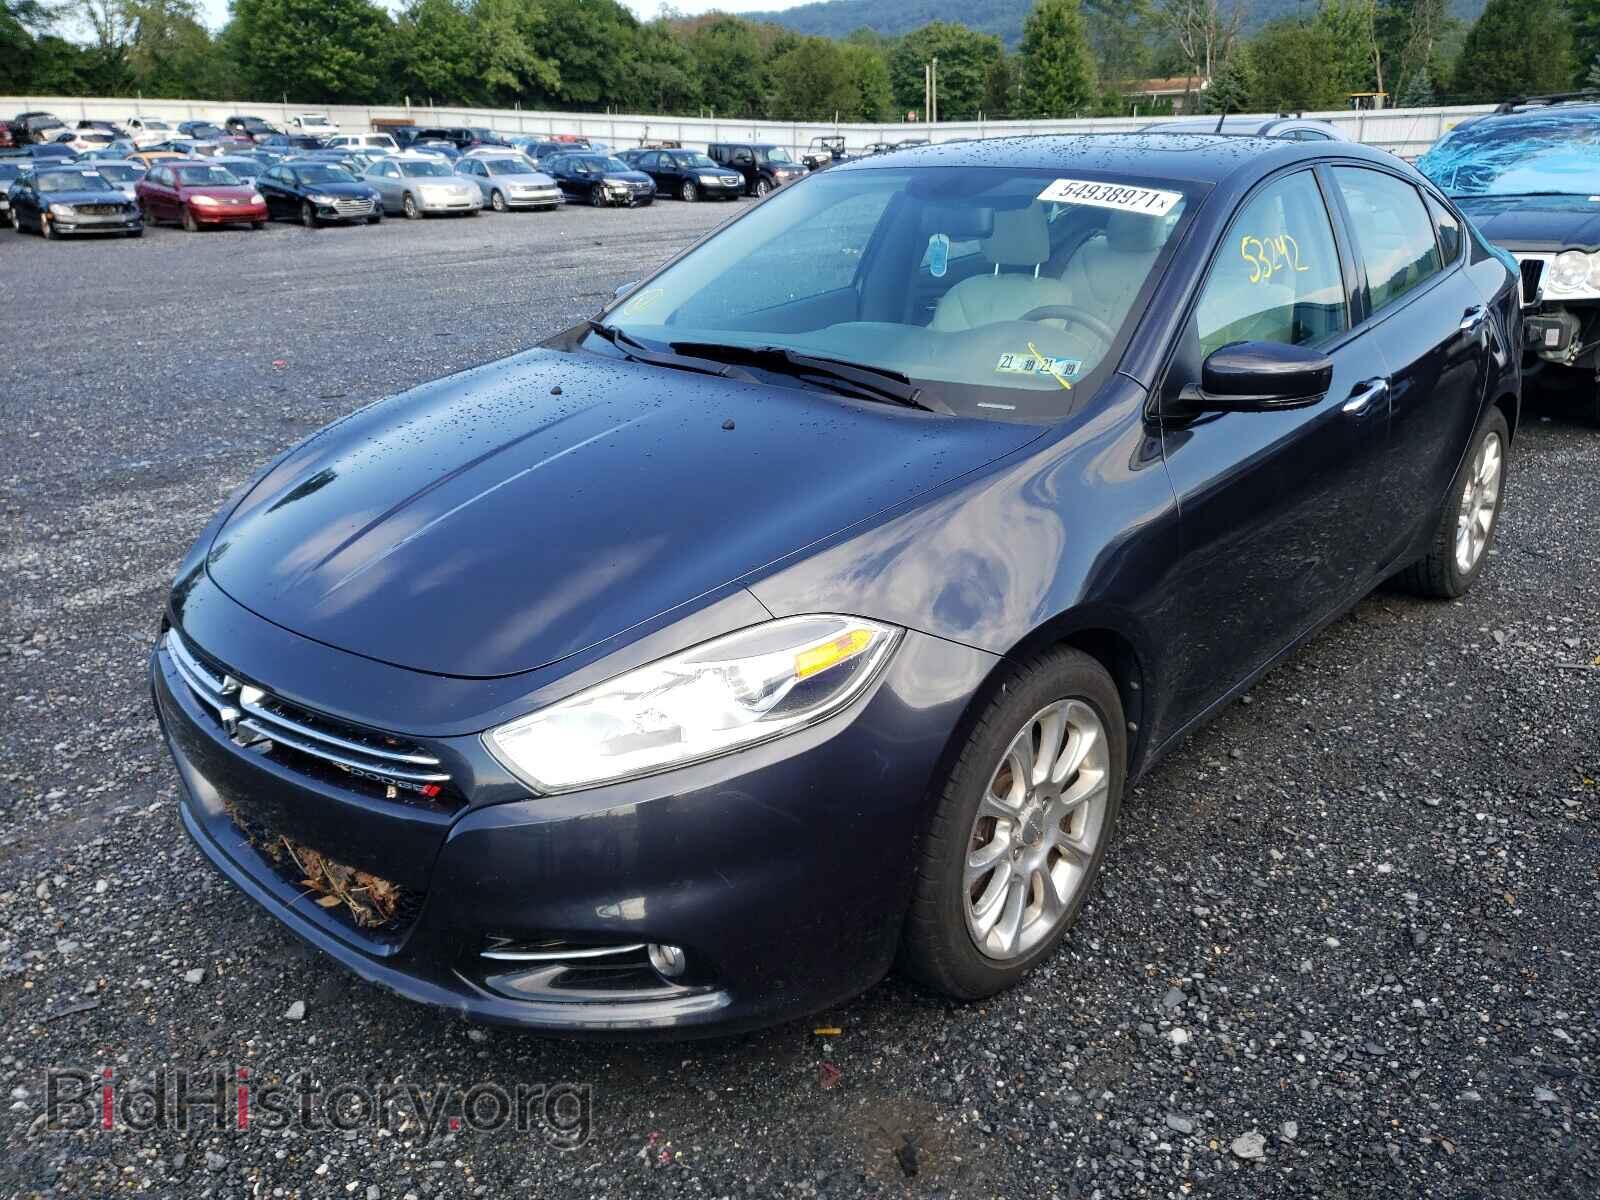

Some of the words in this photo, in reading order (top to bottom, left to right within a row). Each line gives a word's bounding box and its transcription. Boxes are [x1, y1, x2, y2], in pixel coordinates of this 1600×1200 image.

[1058, 182, 1161, 208] 54938971
[1241, 234, 1309, 283] 53242
[351, 767, 426, 793] DODGE
